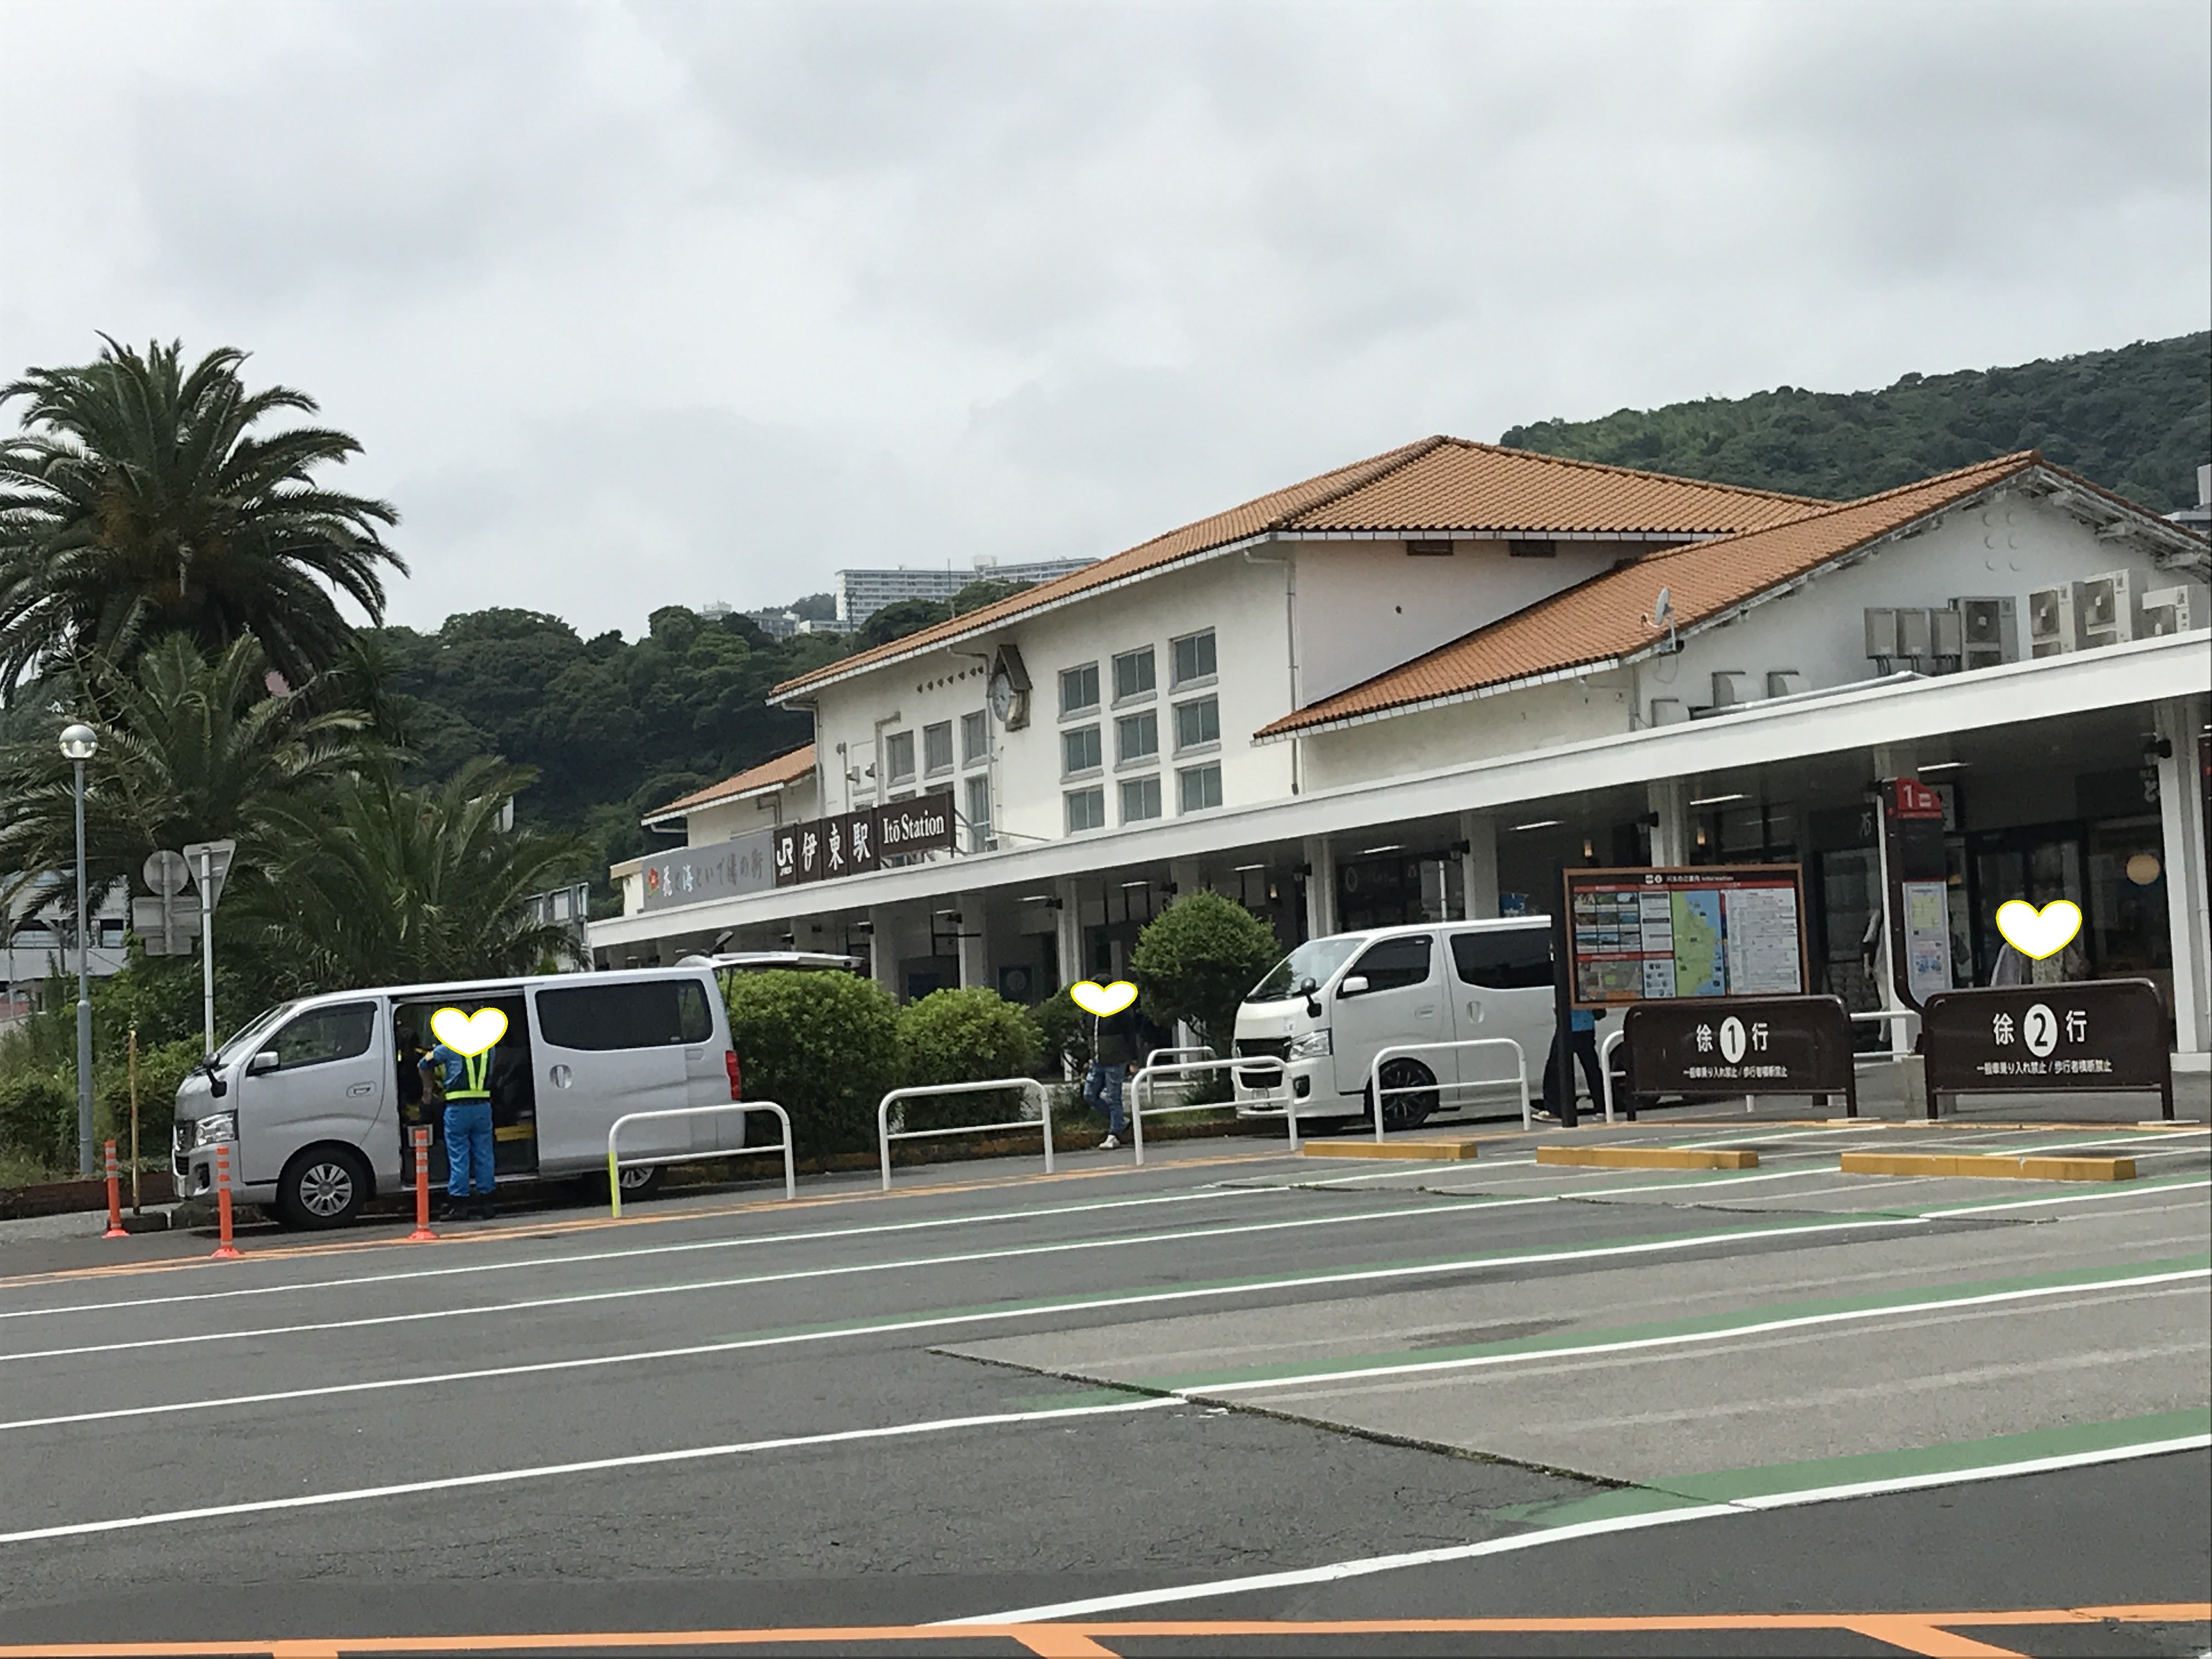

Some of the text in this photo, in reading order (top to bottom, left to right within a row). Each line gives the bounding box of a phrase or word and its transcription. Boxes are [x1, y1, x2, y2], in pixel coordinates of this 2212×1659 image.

[1903, 785, 1913, 808] 1
[883, 809, 945, 844] Itō Station
[776, 822, 871, 872] JR 伊東駅
[1696, 1023, 1769, 1054] 徐 1 行
[1993, 1010, 2087, 1047] 徐 2 行
